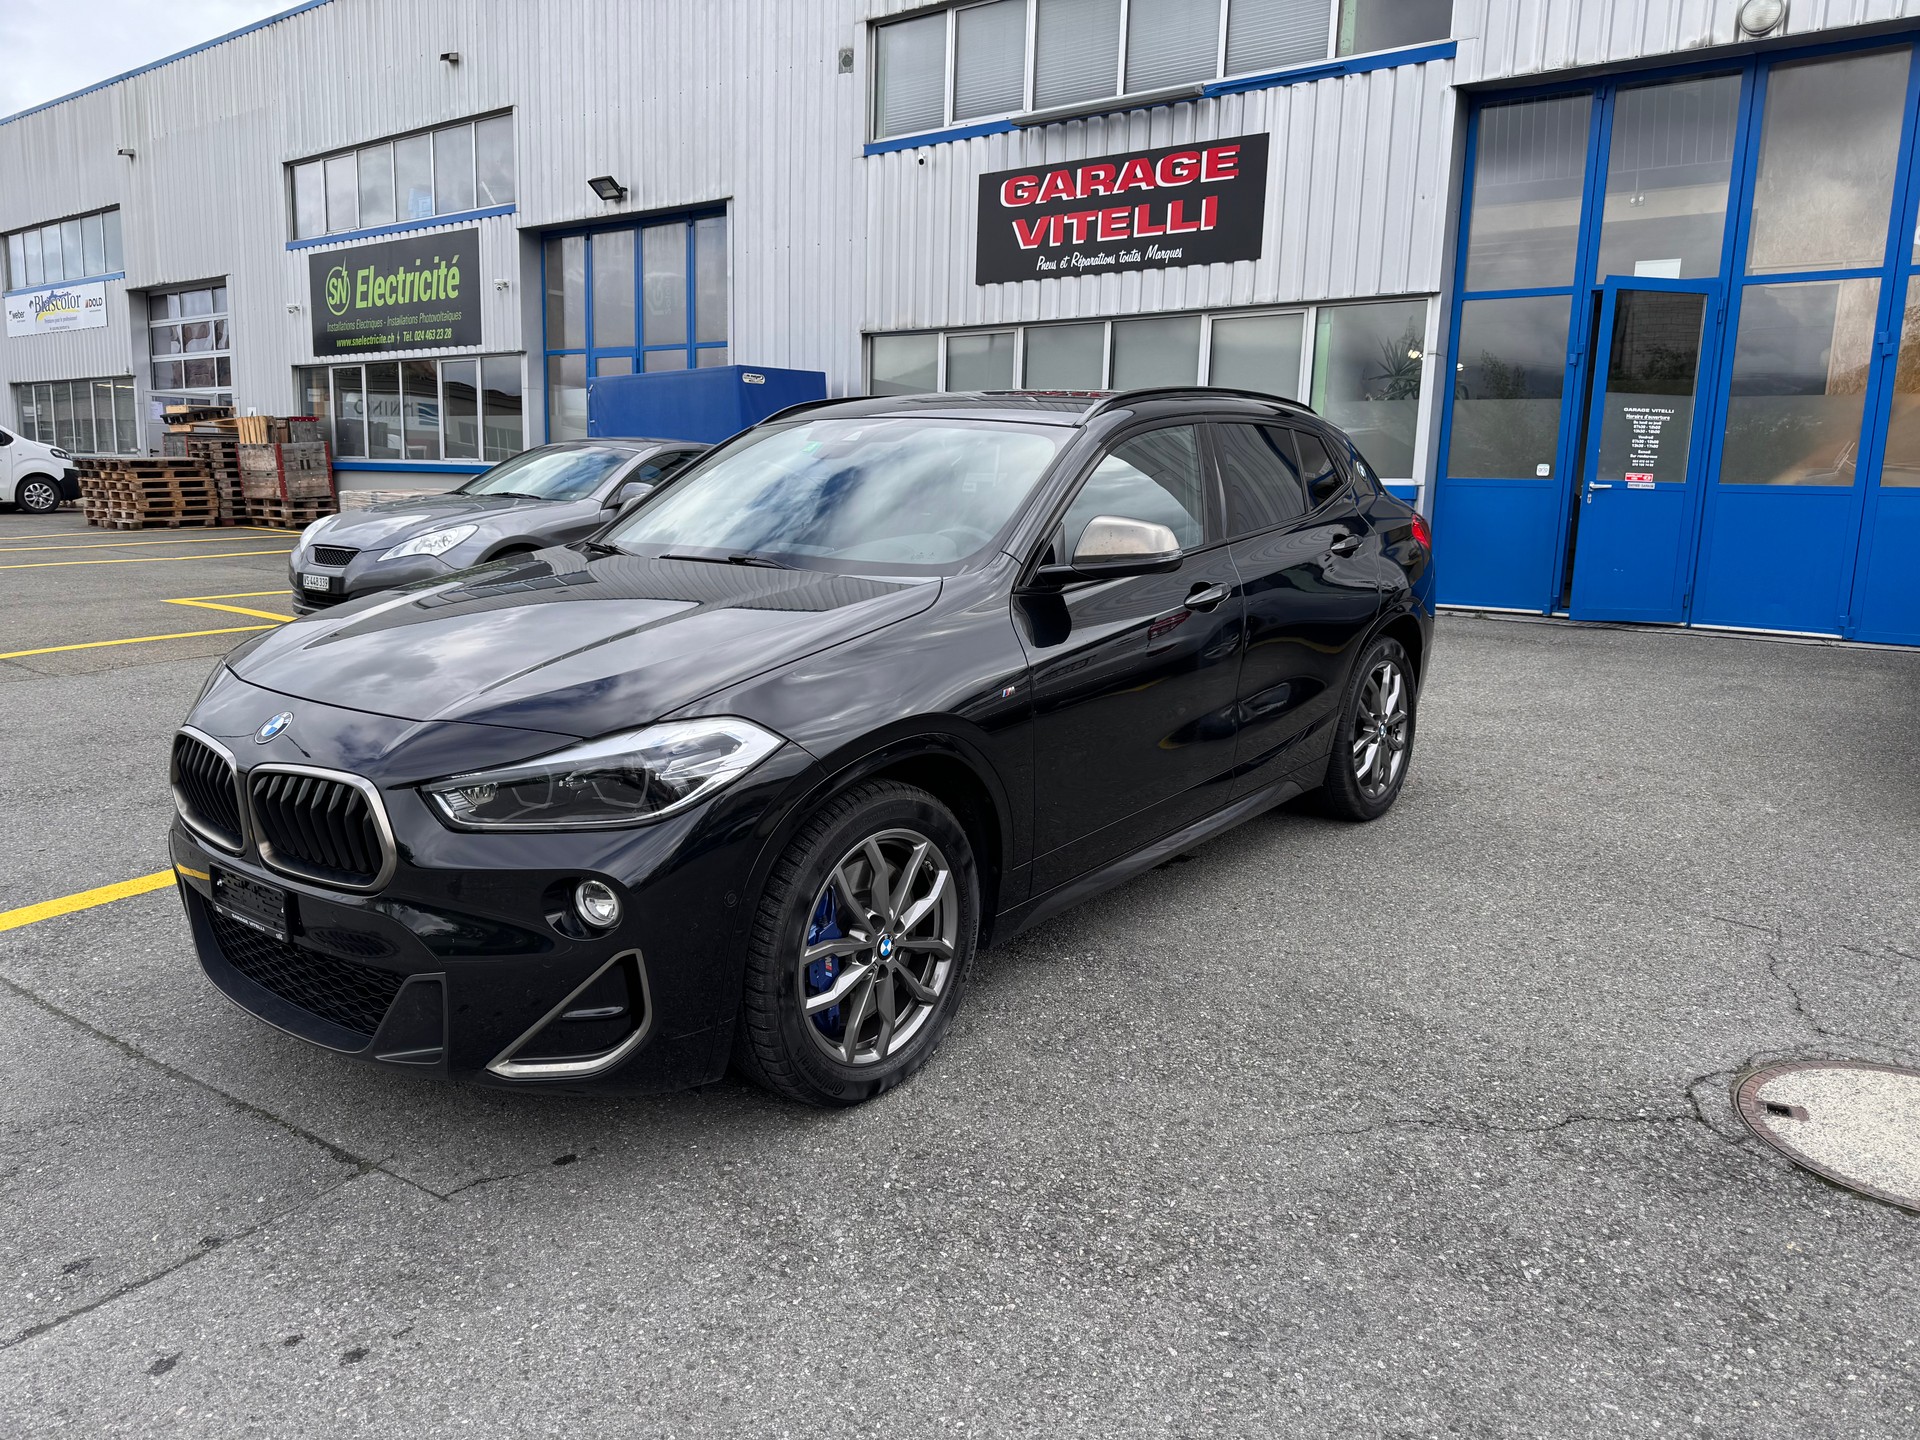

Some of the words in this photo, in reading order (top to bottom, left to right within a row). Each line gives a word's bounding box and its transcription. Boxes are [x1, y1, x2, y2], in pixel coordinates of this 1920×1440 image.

[1000, 144, 1241, 208] GARAGE
[1012, 195, 1218, 249] VITELLI
[1036, 255, 1057, 271] Pneus
[1060, 256, 1070, 269] et
[1071, 252, 1116, 271] Réparations
[1119, 248, 1141, 263] toutes
[1145, 244, 1183, 263] Marques
[328, 272, 348, 305] SN
[355, 254, 460, 309] Electricité
[34, 293, 81, 313] Blascolor
[88, 297, 103, 308] DOLD
[12, 310, 25, 320] weber
[327, 320, 355, 332] Installations
[387, 314, 418, 327] Installations
[336, 332, 395, 348] www.snelectricite.ch
[403, 331, 413, 342] Tél.
[414, 330, 425, 341] 024
[425, 329, 436, 340] 463
[436, 328, 443, 340] 23
[444, 327, 452, 339] 28
